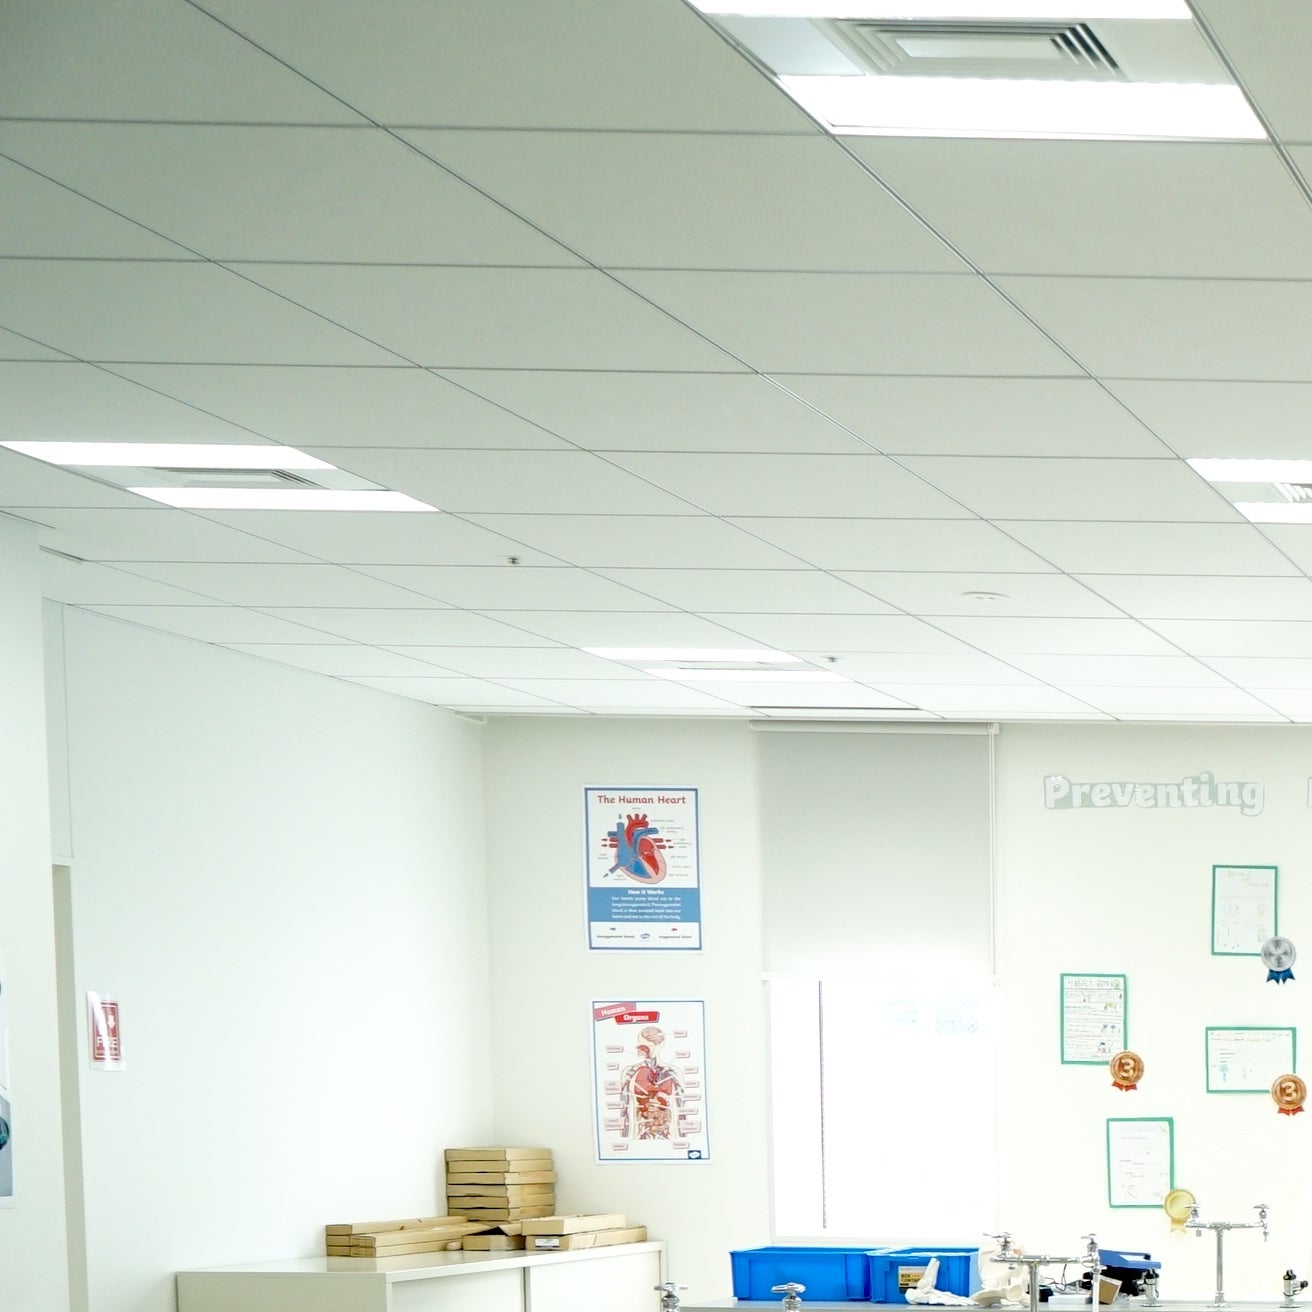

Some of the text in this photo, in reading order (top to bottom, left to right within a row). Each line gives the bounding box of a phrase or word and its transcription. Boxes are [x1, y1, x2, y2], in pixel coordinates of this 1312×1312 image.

[597, 795, 686, 804] The Human Heart
[1044, 772, 1264, 816] Preventing
[1120, 1058, 1135, 1078] 3
[1281, 1082, 1297, 1100] 3
